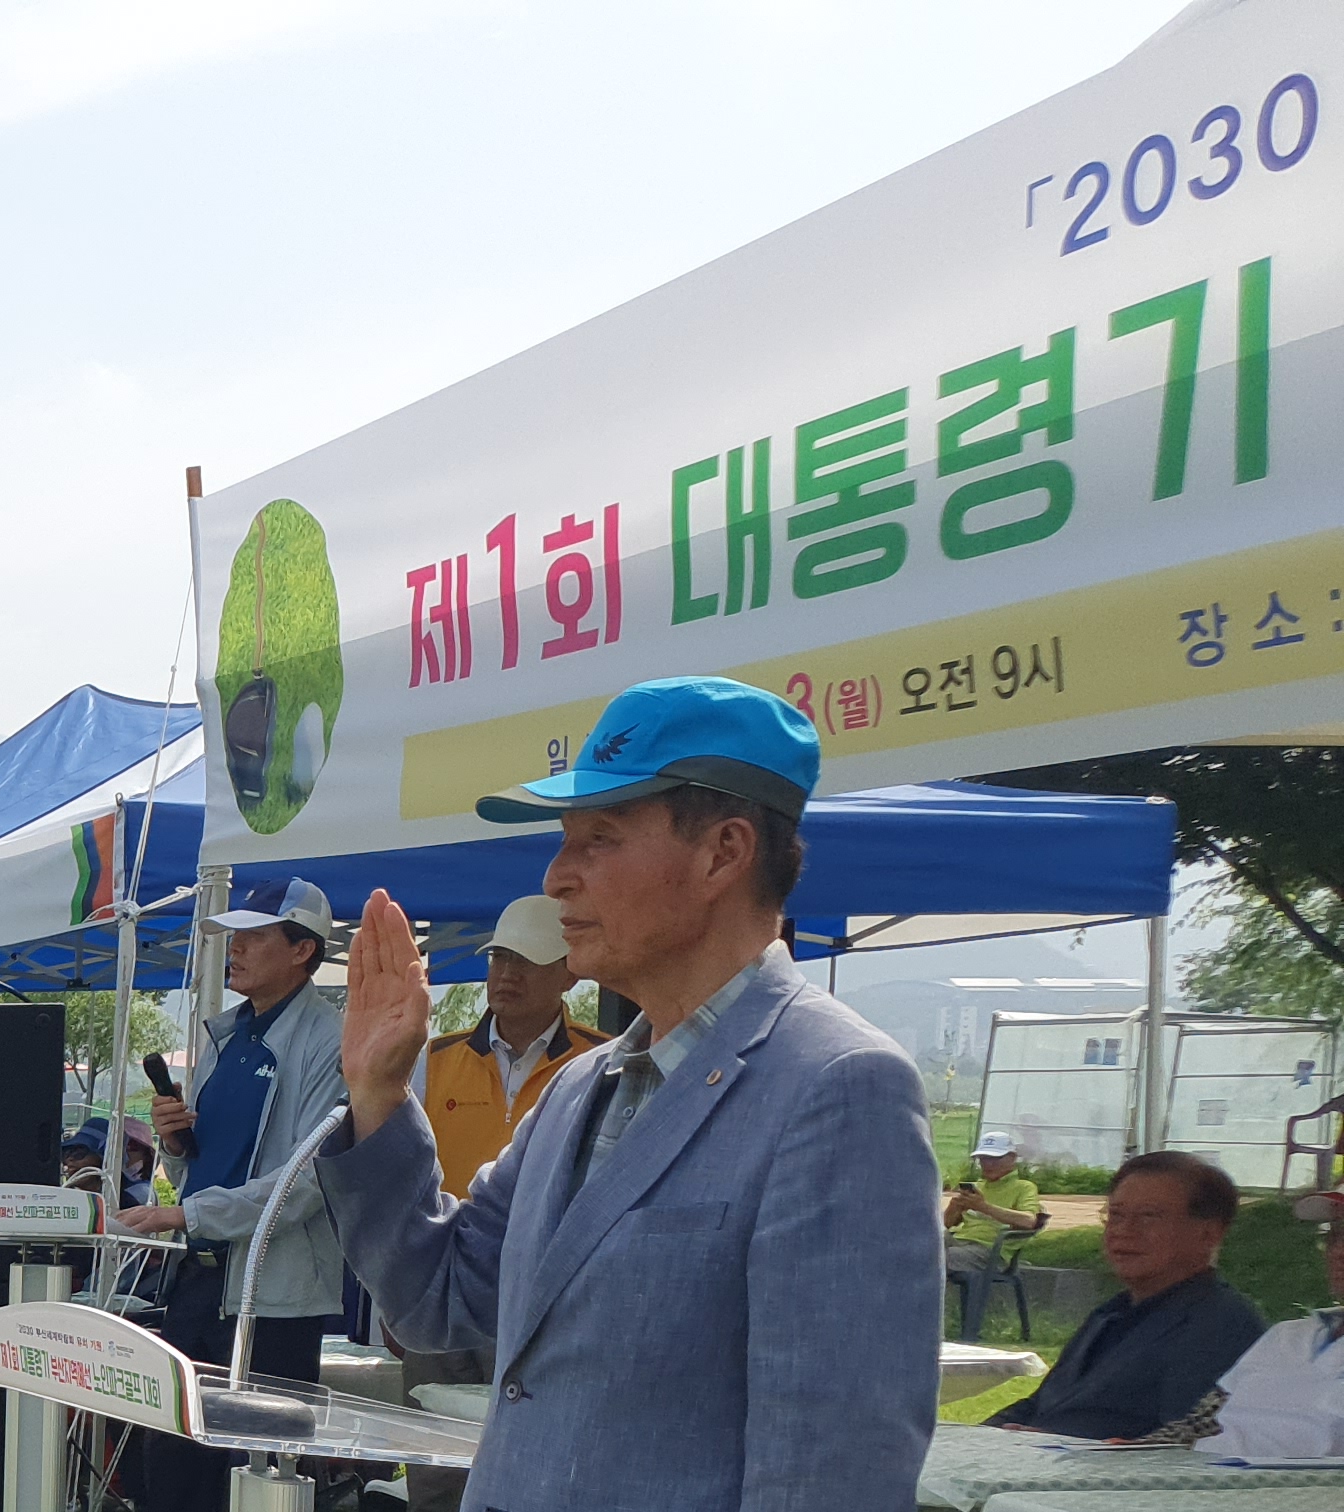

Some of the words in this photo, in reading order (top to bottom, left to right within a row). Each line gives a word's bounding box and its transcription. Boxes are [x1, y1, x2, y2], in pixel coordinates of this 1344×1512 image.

[406, 502, 622, 688] 제1회
[670, 256, 1272, 627] 대통령기
[899, 654, 978, 716] 오전
[992, 636, 1065, 700] 9시
